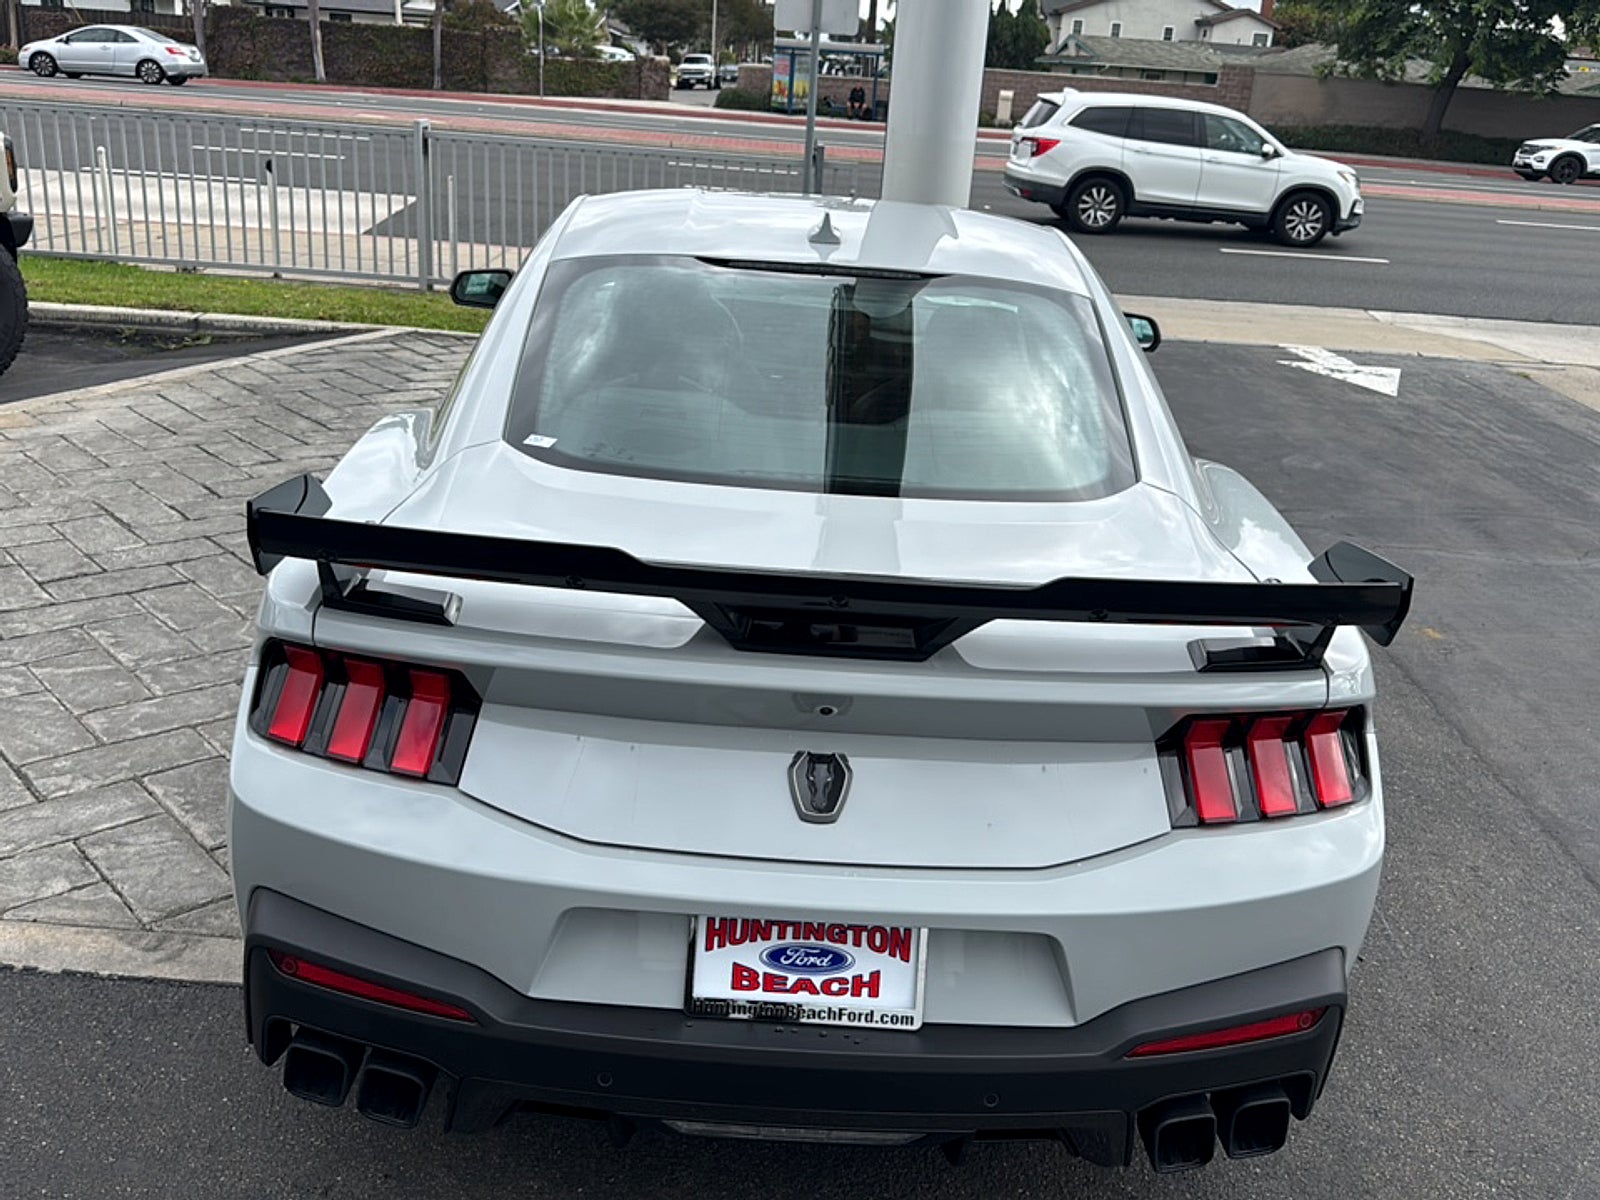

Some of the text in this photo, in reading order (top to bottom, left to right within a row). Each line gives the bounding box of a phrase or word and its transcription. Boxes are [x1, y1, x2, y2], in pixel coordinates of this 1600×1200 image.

[705, 916, 913, 962] HUNTINGTON
[780, 947, 833, 967] Ford
[731, 962, 881, 998] BEACH
[693, 998, 915, 1027] HuntingtonBeachFord.com
